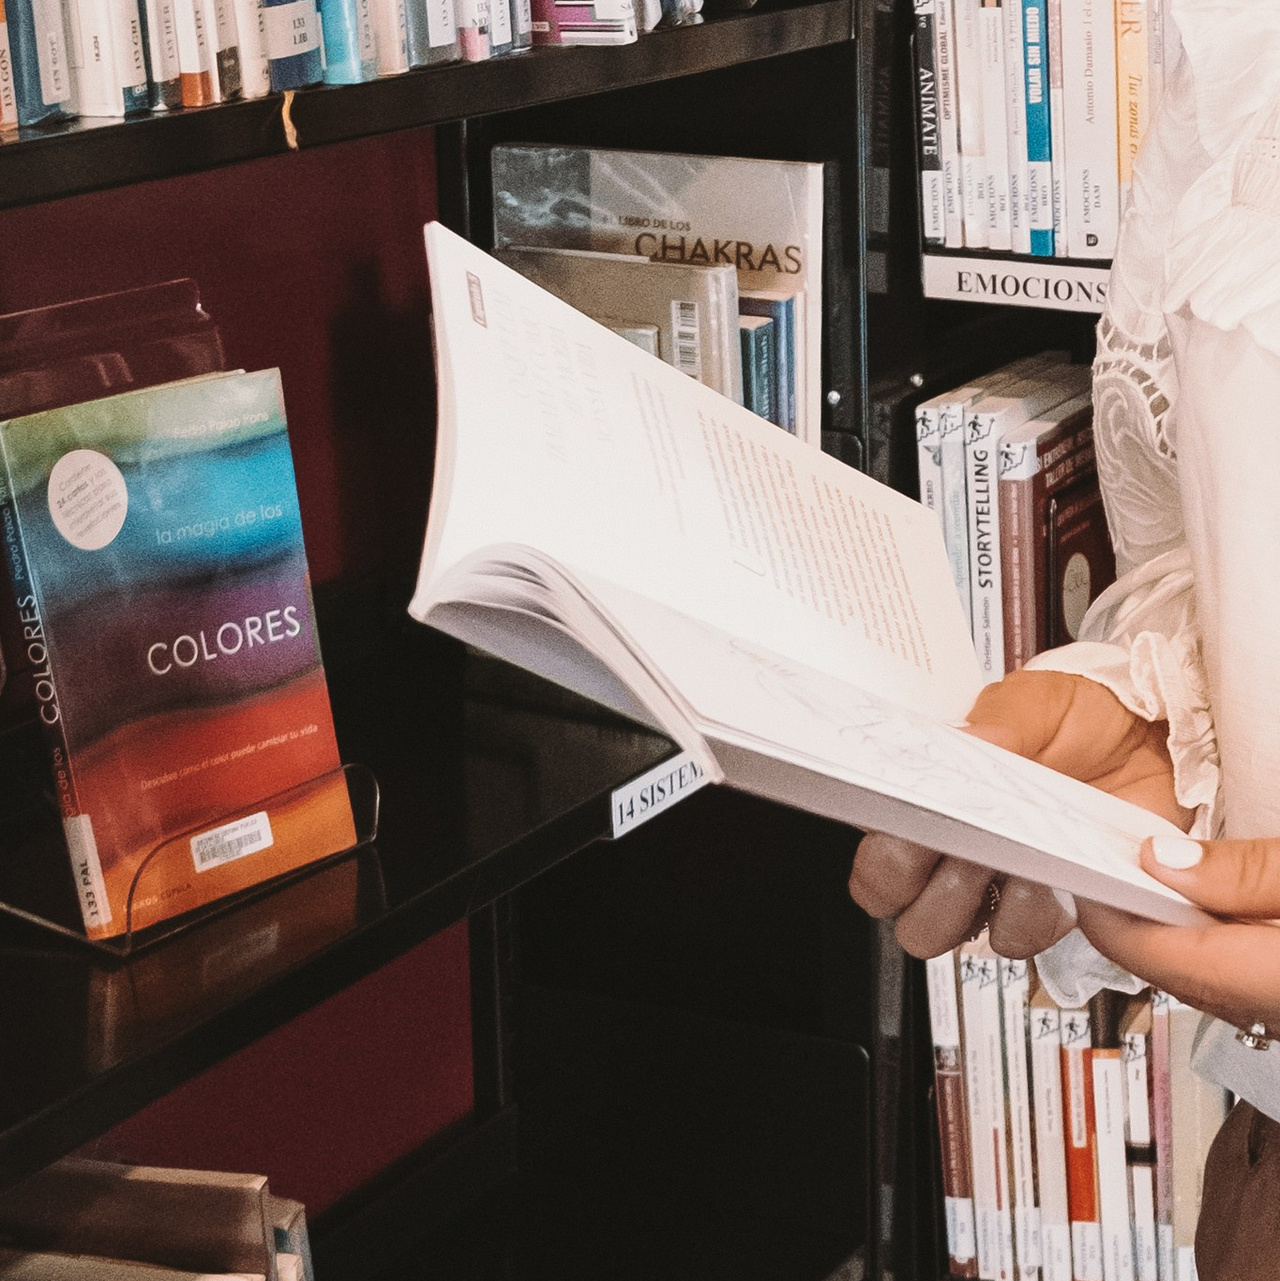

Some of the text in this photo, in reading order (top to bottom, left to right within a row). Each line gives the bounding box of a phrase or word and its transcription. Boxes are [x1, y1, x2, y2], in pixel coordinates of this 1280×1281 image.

[938, 30, 950, 65] GLOBAL
[1026, 6, 1042, 104] VOLAR SIN MIEDO
[1083, 30, 1095, 78] Damasio
[940, 67, 952, 121] OPTIMISME
[1084, 80, 1096, 125] Antonio
[1081, 168, 1091, 224] EMOCIONS
[653, 217, 666, 230] DE
[669, 219, 691, 232] LOS
[634, 231, 802, 274] CHAKRAS
[956, 271, 1107, 305] EMOCIONS
[155, 502, 283, 545] la magia de los
[973, 449, 994, 589] STORYTELLING
[18, 595, 60, 725] COLORES
[148, 606, 302, 677] COLORES
[982, 631, 993, 672] Christian
[640, 760, 705, 813] SISTEM
[79, 859, 99, 917] 133 PAL
